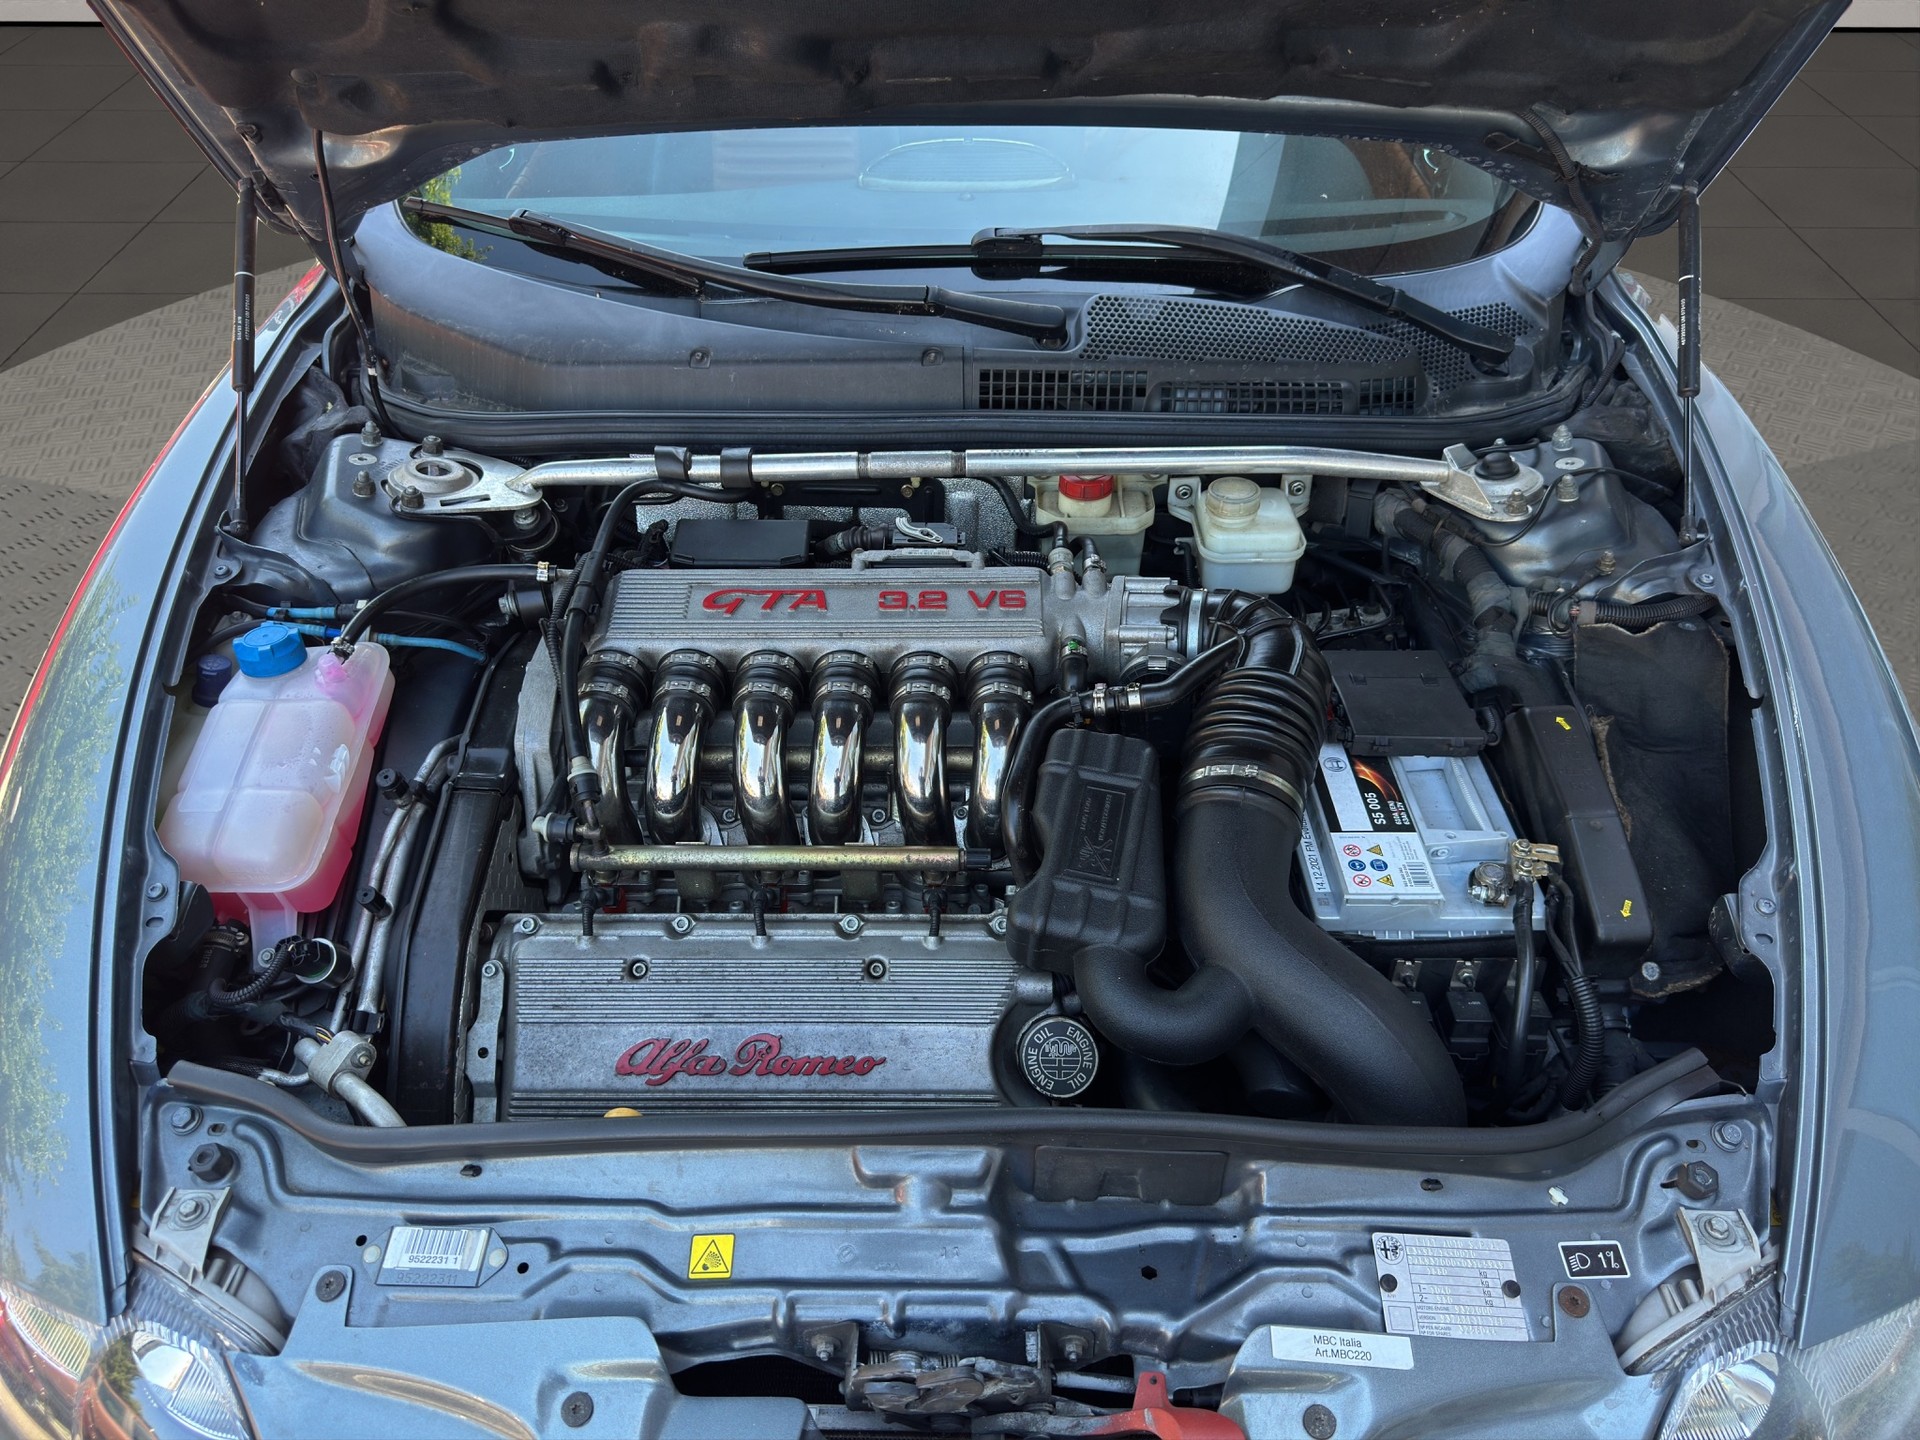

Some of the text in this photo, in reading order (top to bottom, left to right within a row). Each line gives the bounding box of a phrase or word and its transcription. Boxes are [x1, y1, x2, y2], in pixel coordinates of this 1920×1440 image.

[702, 588, 1027, 616] GTA 3.2 V6
[1364, 792, 1386, 825] S5 005
[1304, 841, 1315, 852] FM
[1308, 854, 1326, 890] 14.12.2021
[615, 1033, 887, 1086] Alfa Romeo
[1028, 1027, 1054, 1090] ENGINE OIL
[1066, 1026, 1093, 1089] ENGINE OIL
[408, 1255, 448, 1264] 9522231
[1598, 1251, 1620, 1268] 1%
[395, 1272, 458, 1285] 95222311
[1479, 1270, 1488, 1278] kg
[1481, 1280, 1490, 1288] kg
[1483, 1289, 1492, 1298] kg
[1485, 1299, 1494, 1307] kg
[1313, 1335, 1362, 1348] MBC Italia
[1315, 1347, 1372, 1361] Art.MBC220
